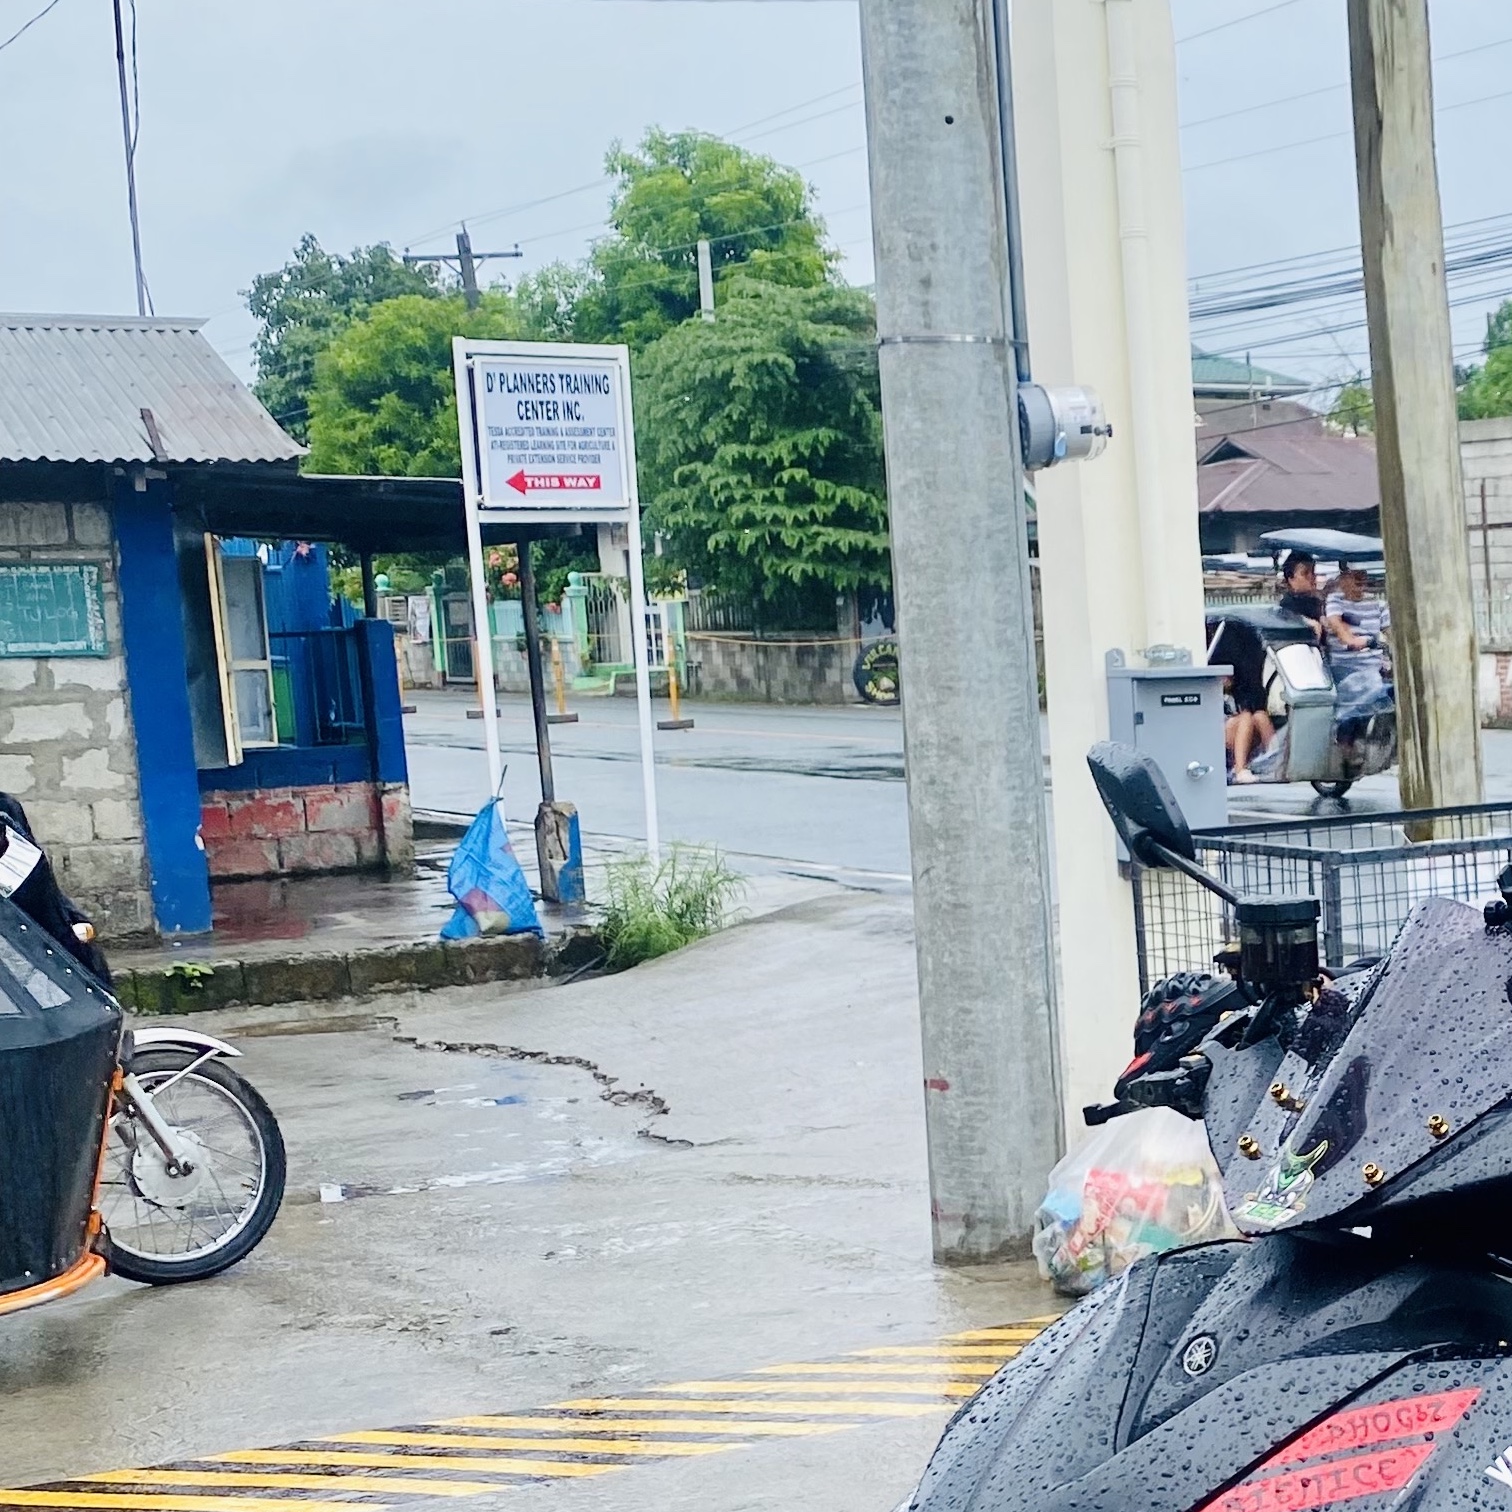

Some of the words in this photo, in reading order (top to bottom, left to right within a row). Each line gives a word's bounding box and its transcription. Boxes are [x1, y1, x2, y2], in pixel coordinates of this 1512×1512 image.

[499, 372, 556, 394] PLANNERS
[559, 374, 610, 395] TRAINING
[517, 400, 560, 421] CENTER
[562, 401, 585, 422] INC.
[525, 477, 560, 488] THIS
[563, 477, 597, 488] WAY
